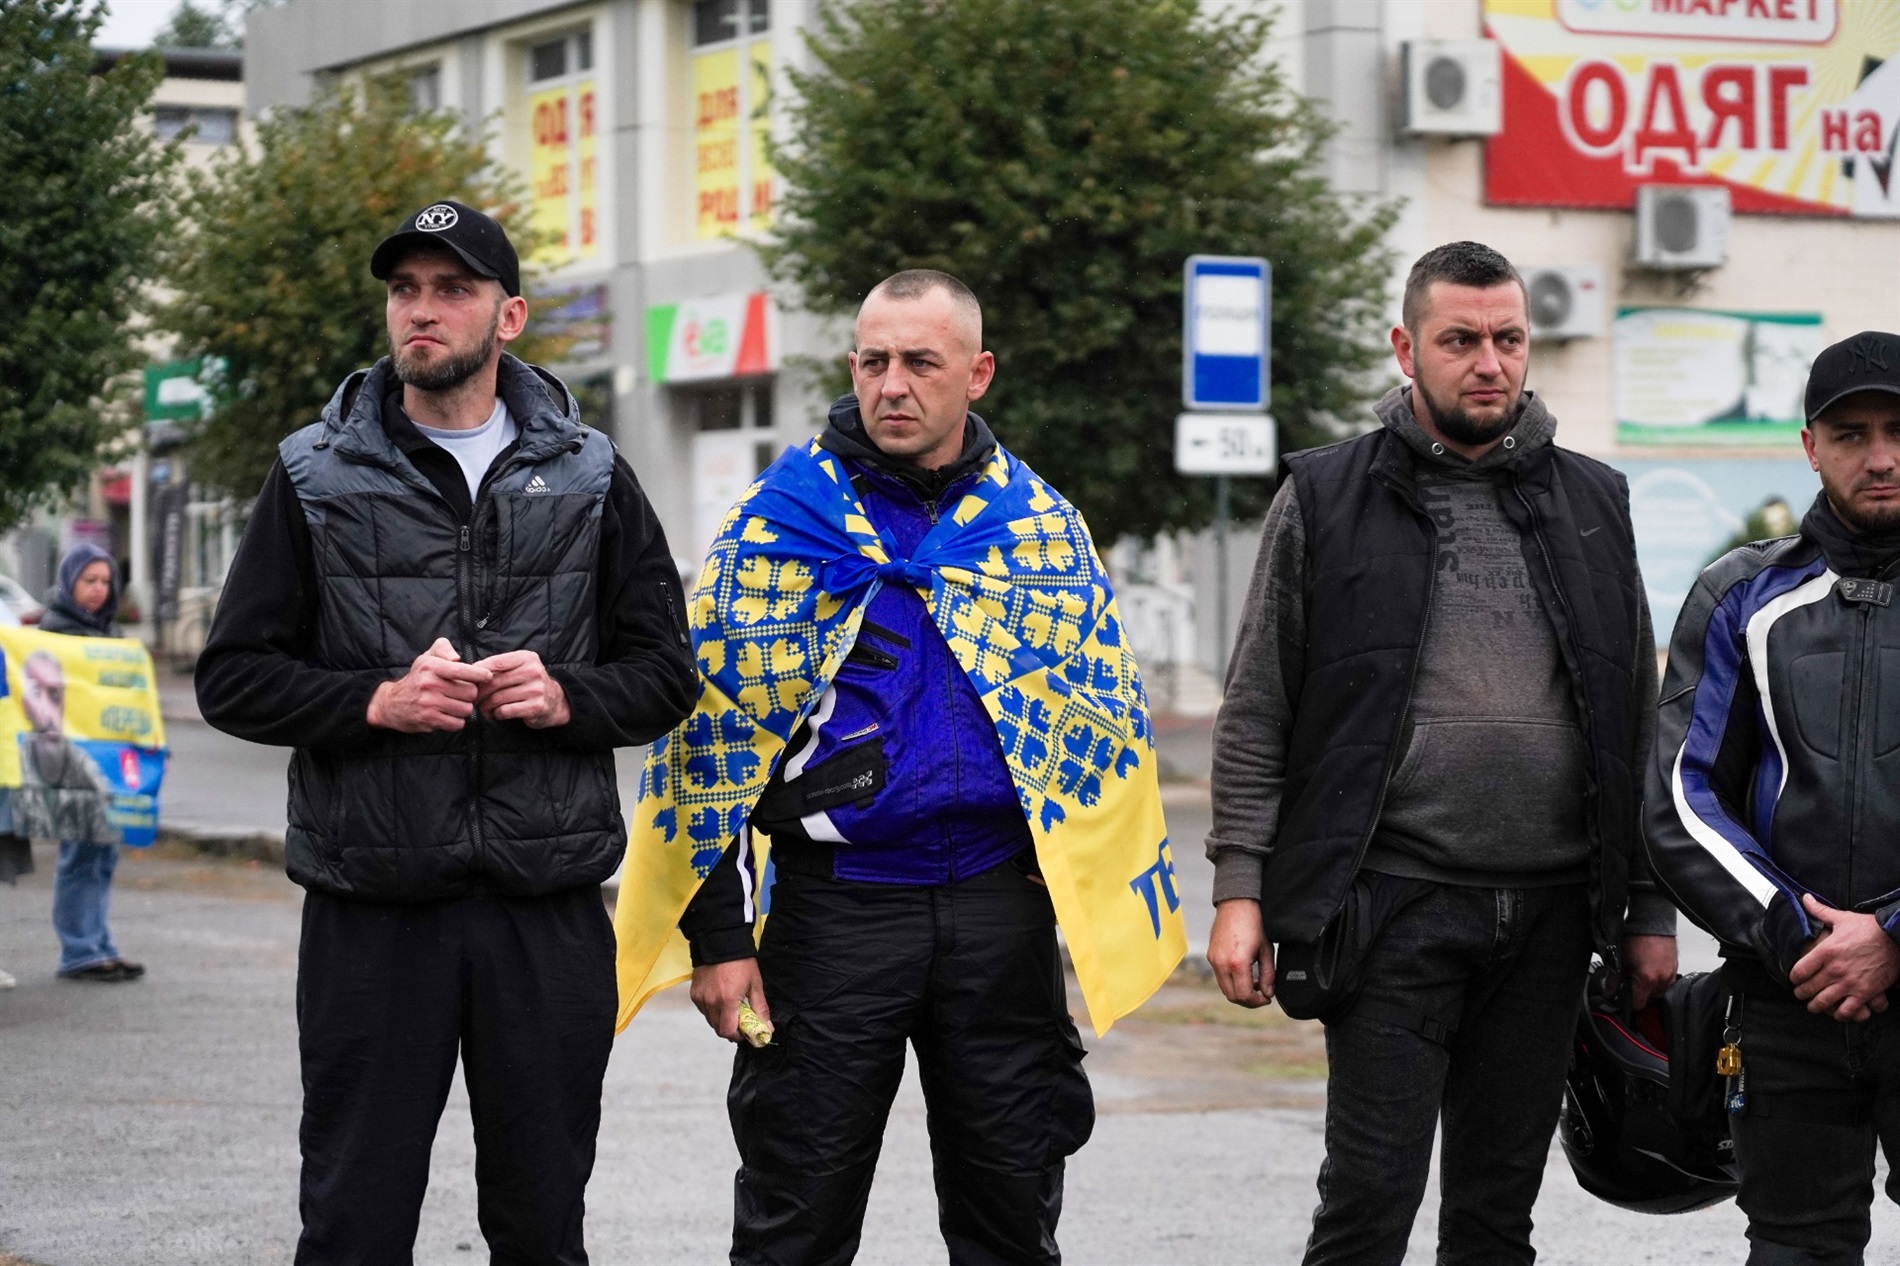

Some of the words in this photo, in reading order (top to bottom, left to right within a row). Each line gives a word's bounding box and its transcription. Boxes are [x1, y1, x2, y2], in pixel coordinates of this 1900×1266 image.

[1569, 60, 1808, 167] ОДЯГ
[1822, 108, 1882, 152] на
[419, 212, 454, 225] NY
